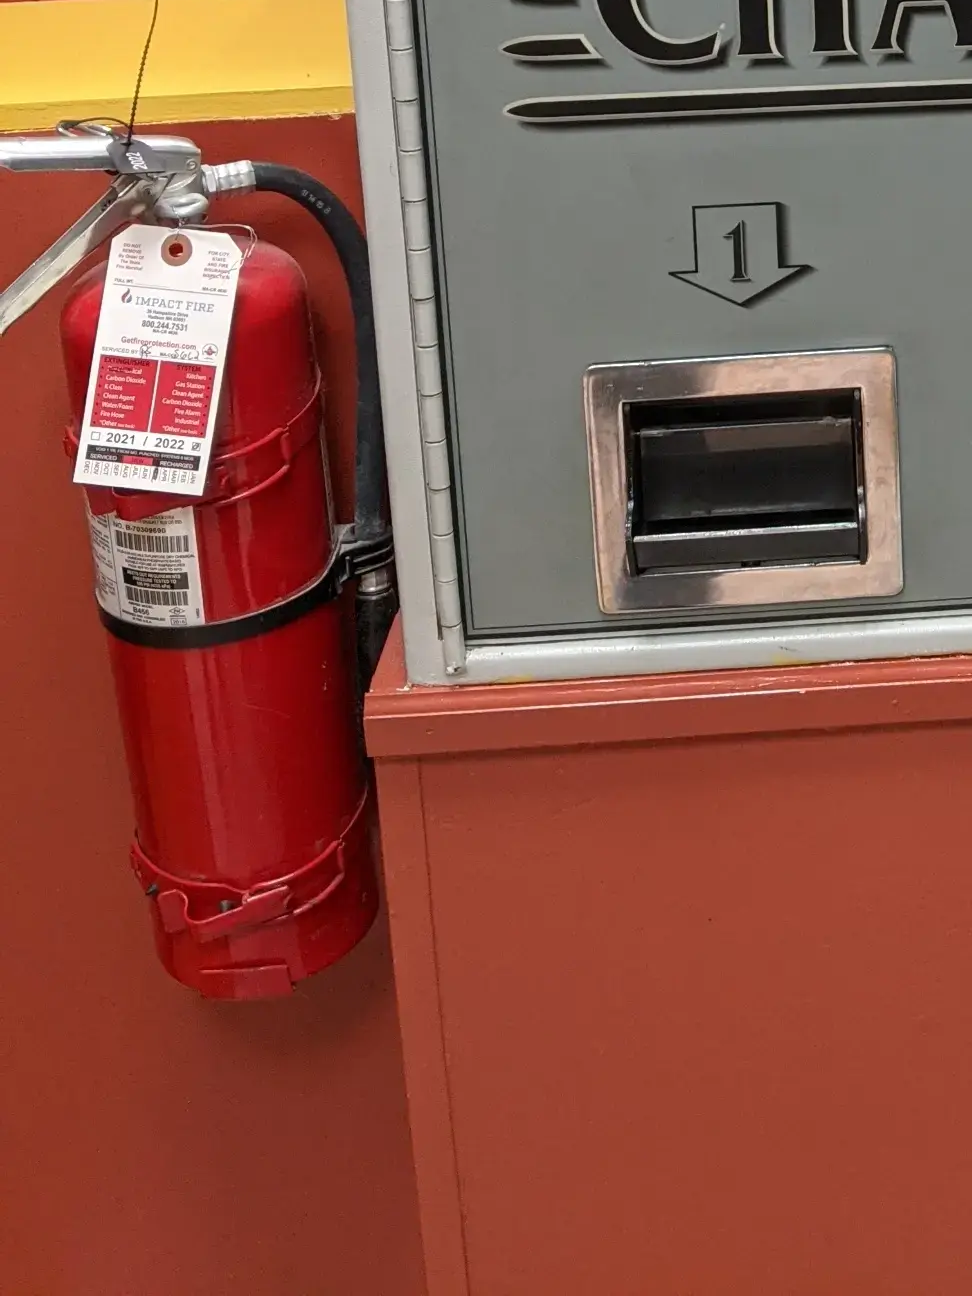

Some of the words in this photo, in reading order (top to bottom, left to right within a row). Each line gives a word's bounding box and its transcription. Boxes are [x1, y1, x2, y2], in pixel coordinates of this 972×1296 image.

[723, 218, 753, 283] 1
[135, 295, 184, 310] IMPACT
[185, 301, 215, 313] FIRE
[141, 319, 188, 332] 800.244.7531
[121, 336, 197, 351] Getfireprotection.com
[101, 346, 129, 354] SERVICED
[104, 357, 150, 366] EXTINGUISHER
[106, 374, 125, 382] Carbon
[126, 376, 146, 384] Dioxide
[186, 382, 205, 390] Station
[119, 394, 135, 402] Agent
[175, 417, 200, 425] Industrial
[106, 432, 135, 445] 2021
[154, 437, 185, 450] 2022
[90, 453, 117, 461] SERVICED
[160, 461, 194, 469] RECHARGED
[189, 472, 197, 484] JAN
